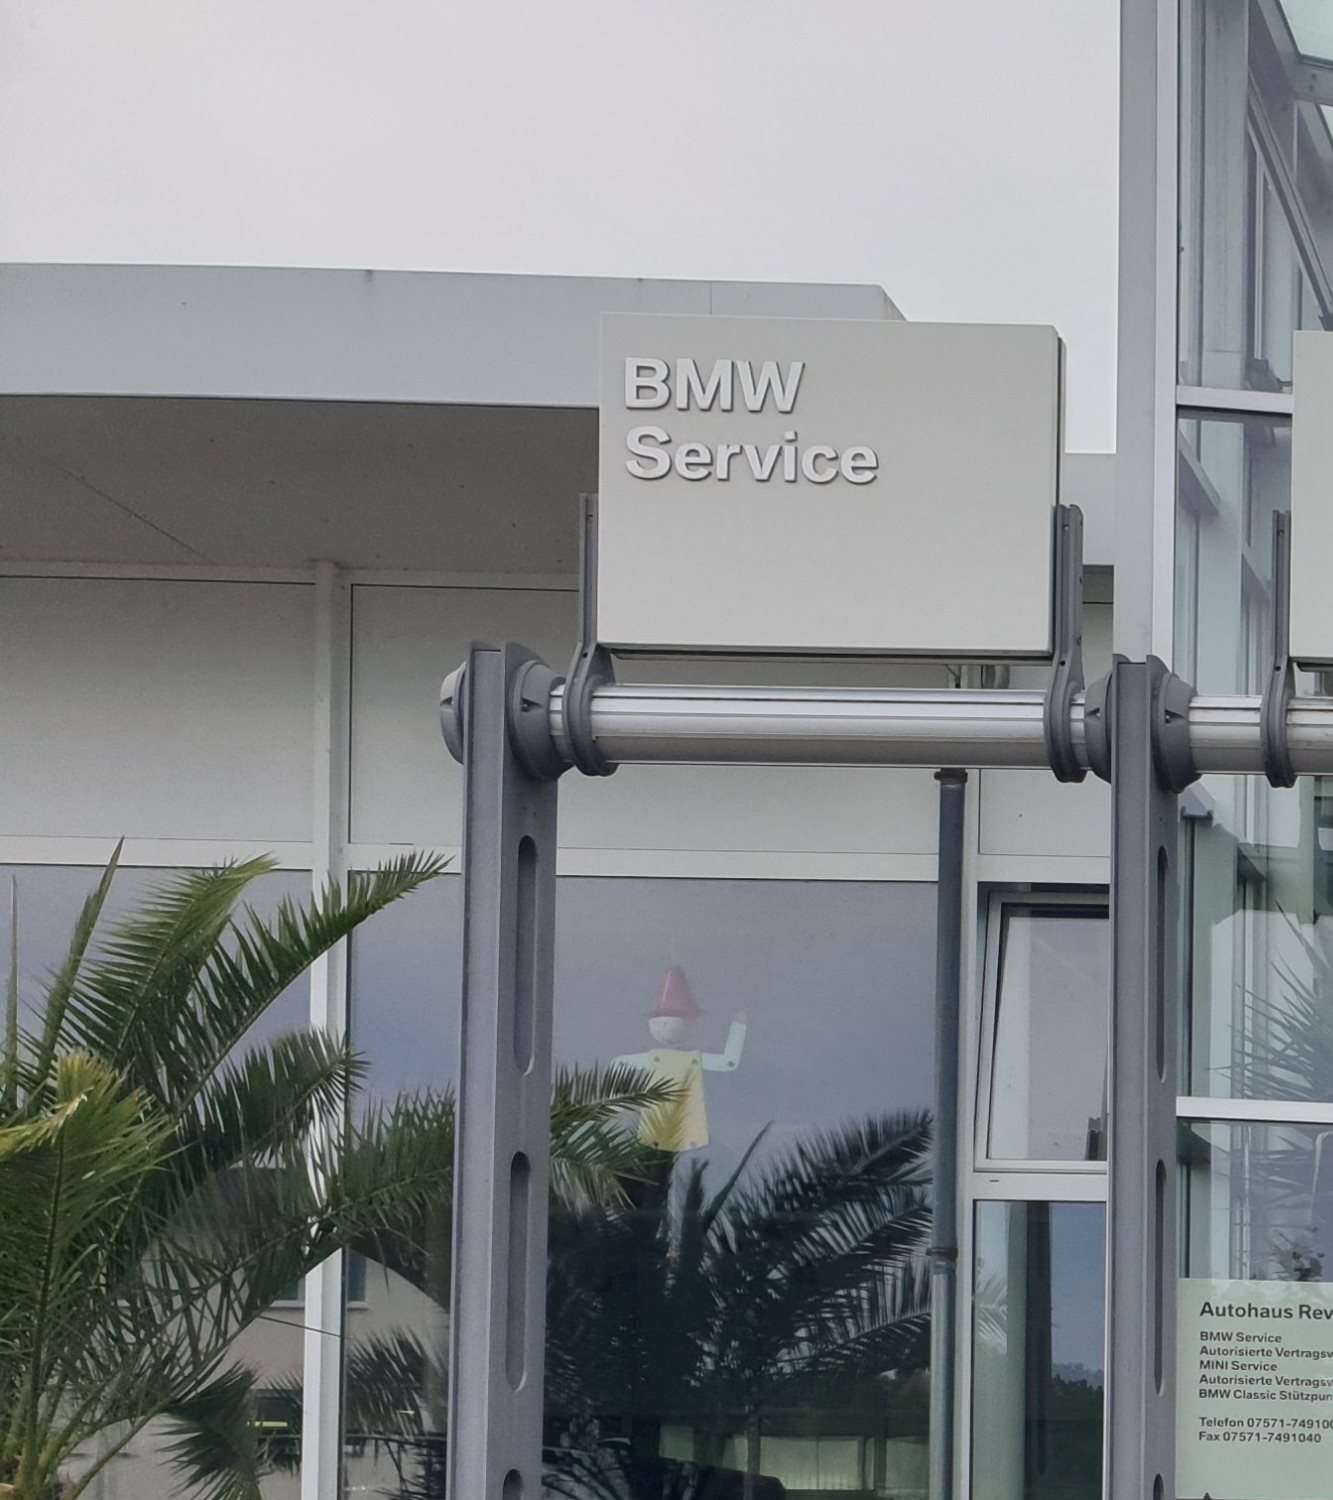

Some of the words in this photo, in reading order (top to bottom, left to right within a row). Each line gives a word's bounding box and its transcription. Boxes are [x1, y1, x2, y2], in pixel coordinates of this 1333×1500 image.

[624, 357, 806, 413] BMW
[625, 425, 879, 484] Service
[1199, 1301, 1294, 1320] Autohaus
[1199, 1331, 1233, 1343] BMW
[1235, 1331, 1283, 1344] Service
[1199, 1345, 1273, 1358] Autorisierte
[1199, 1360, 1228, 1371] MINI
[1231, 1360, 1278, 1372] Service
[1199, 1374, 1273, 1386] Autorisierte
[1199, 1388, 1232, 1399] BMW
[1233, 1389, 1277, 1401] Classic
[1199, 1416, 1245, 1429] Telefon
[1199, 1431, 1221, 1442] Fax
[1223, 1431, 1322, 1444] 07571-7491040
